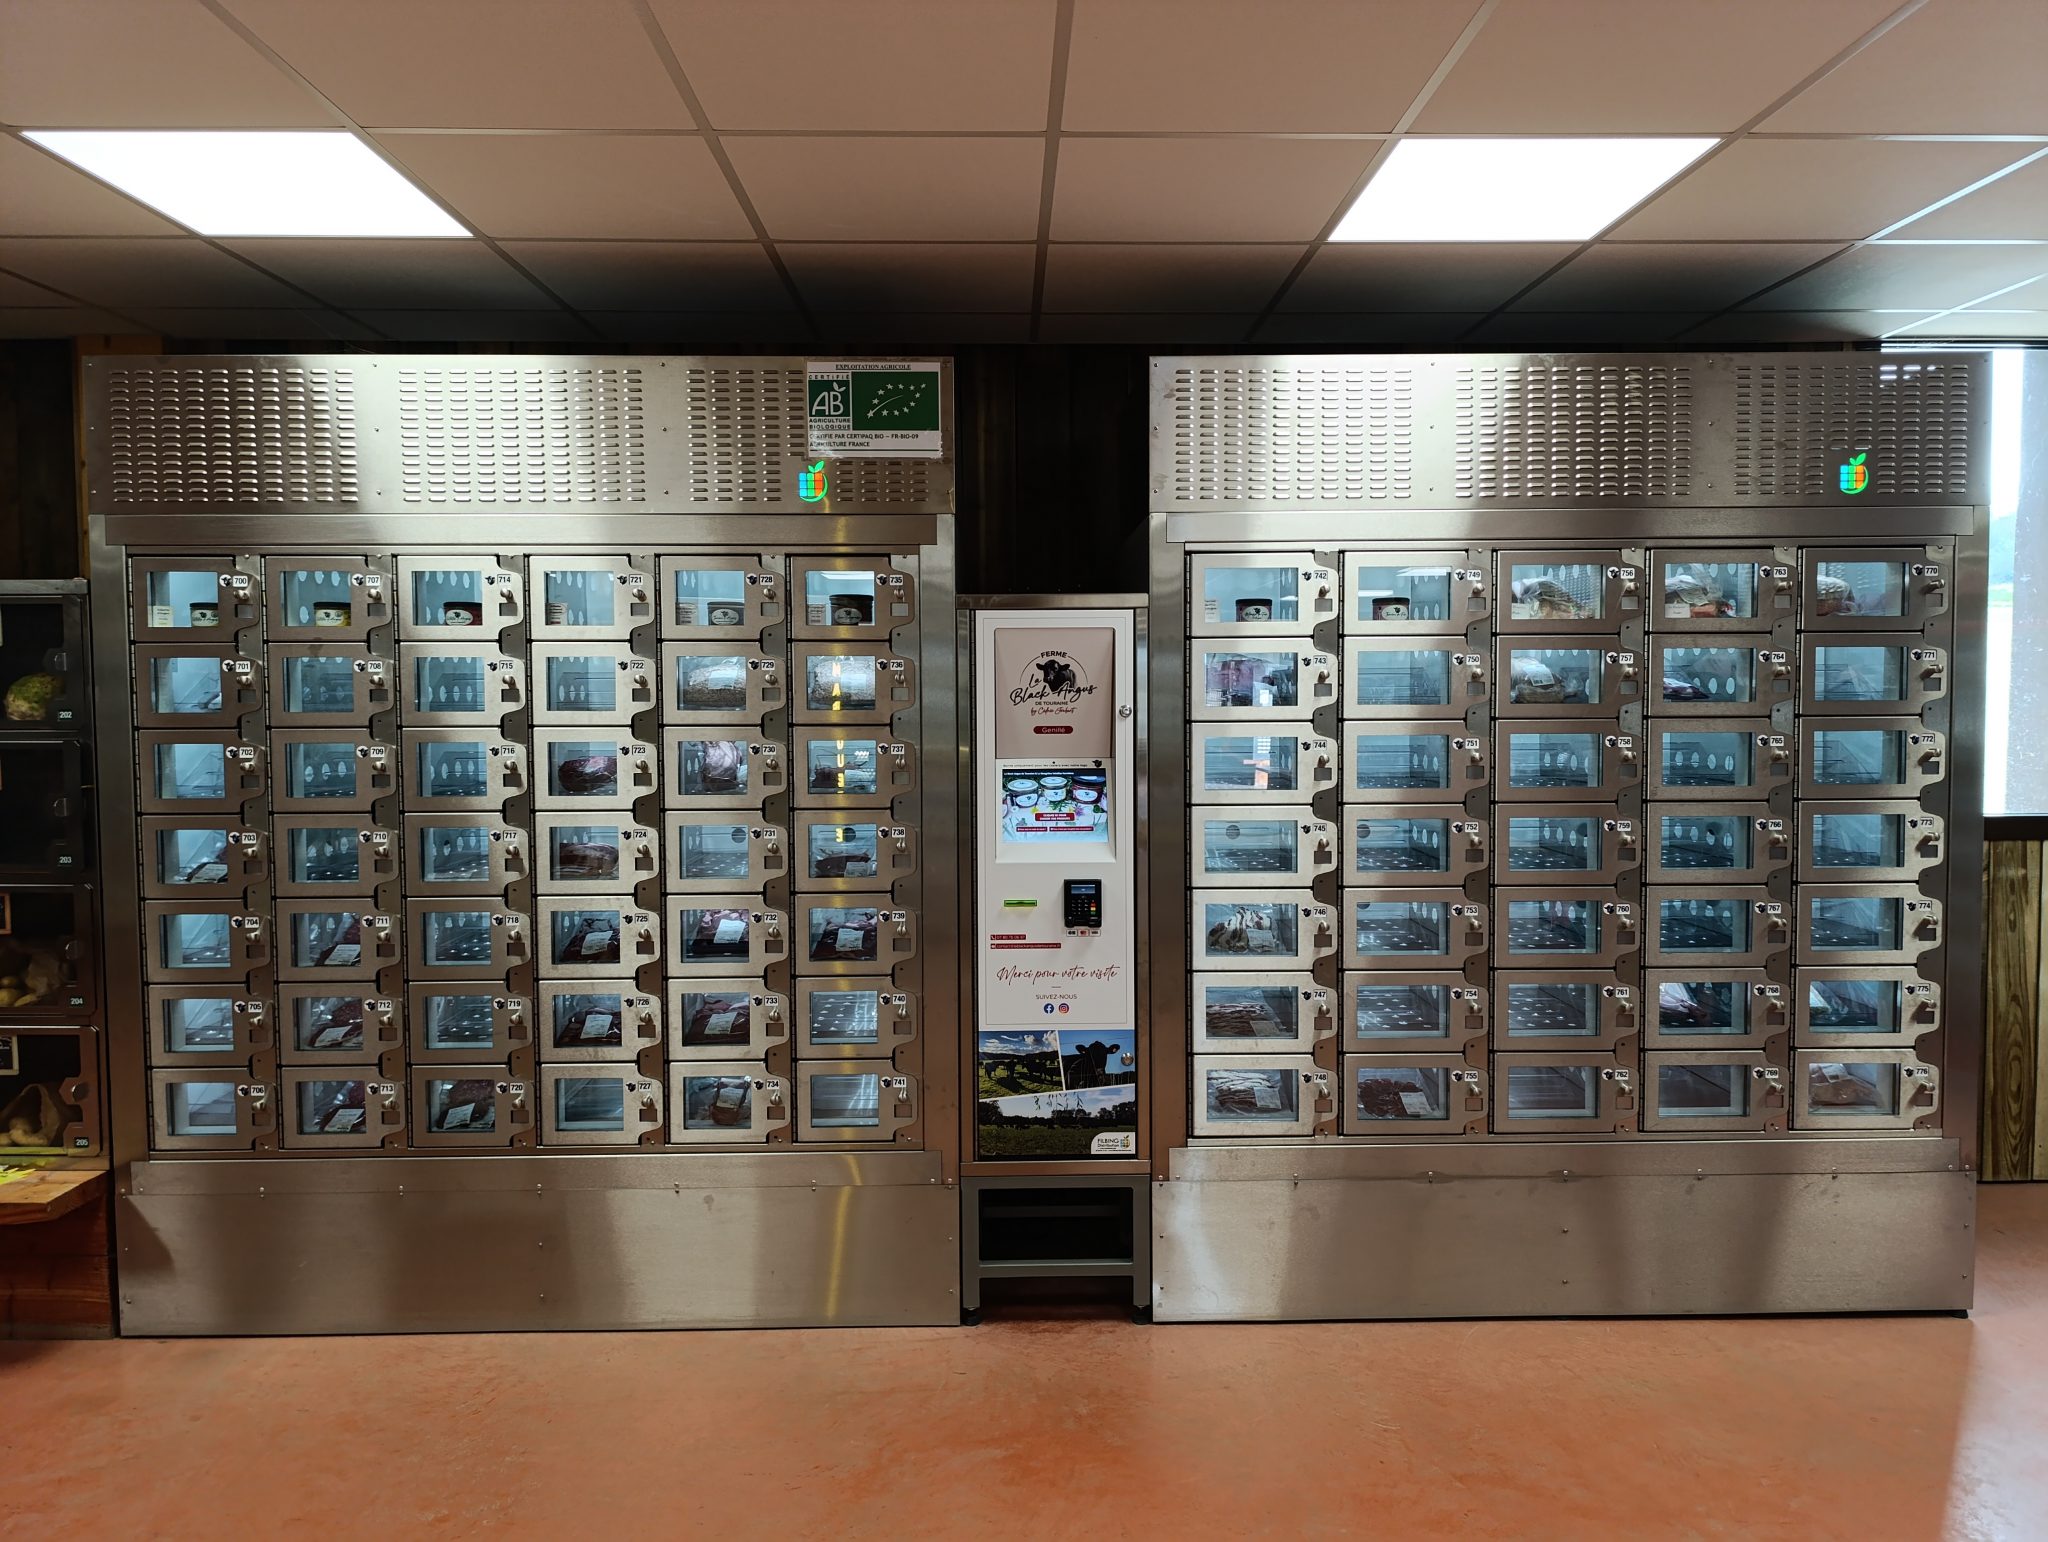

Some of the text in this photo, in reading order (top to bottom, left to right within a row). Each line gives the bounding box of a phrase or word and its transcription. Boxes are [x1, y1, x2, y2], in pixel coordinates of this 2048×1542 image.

[812, 391, 844, 416] AB
[1010, 681, 1097, 706] Black Angus
[997, 964, 1120, 986] Merci pour votre visite
